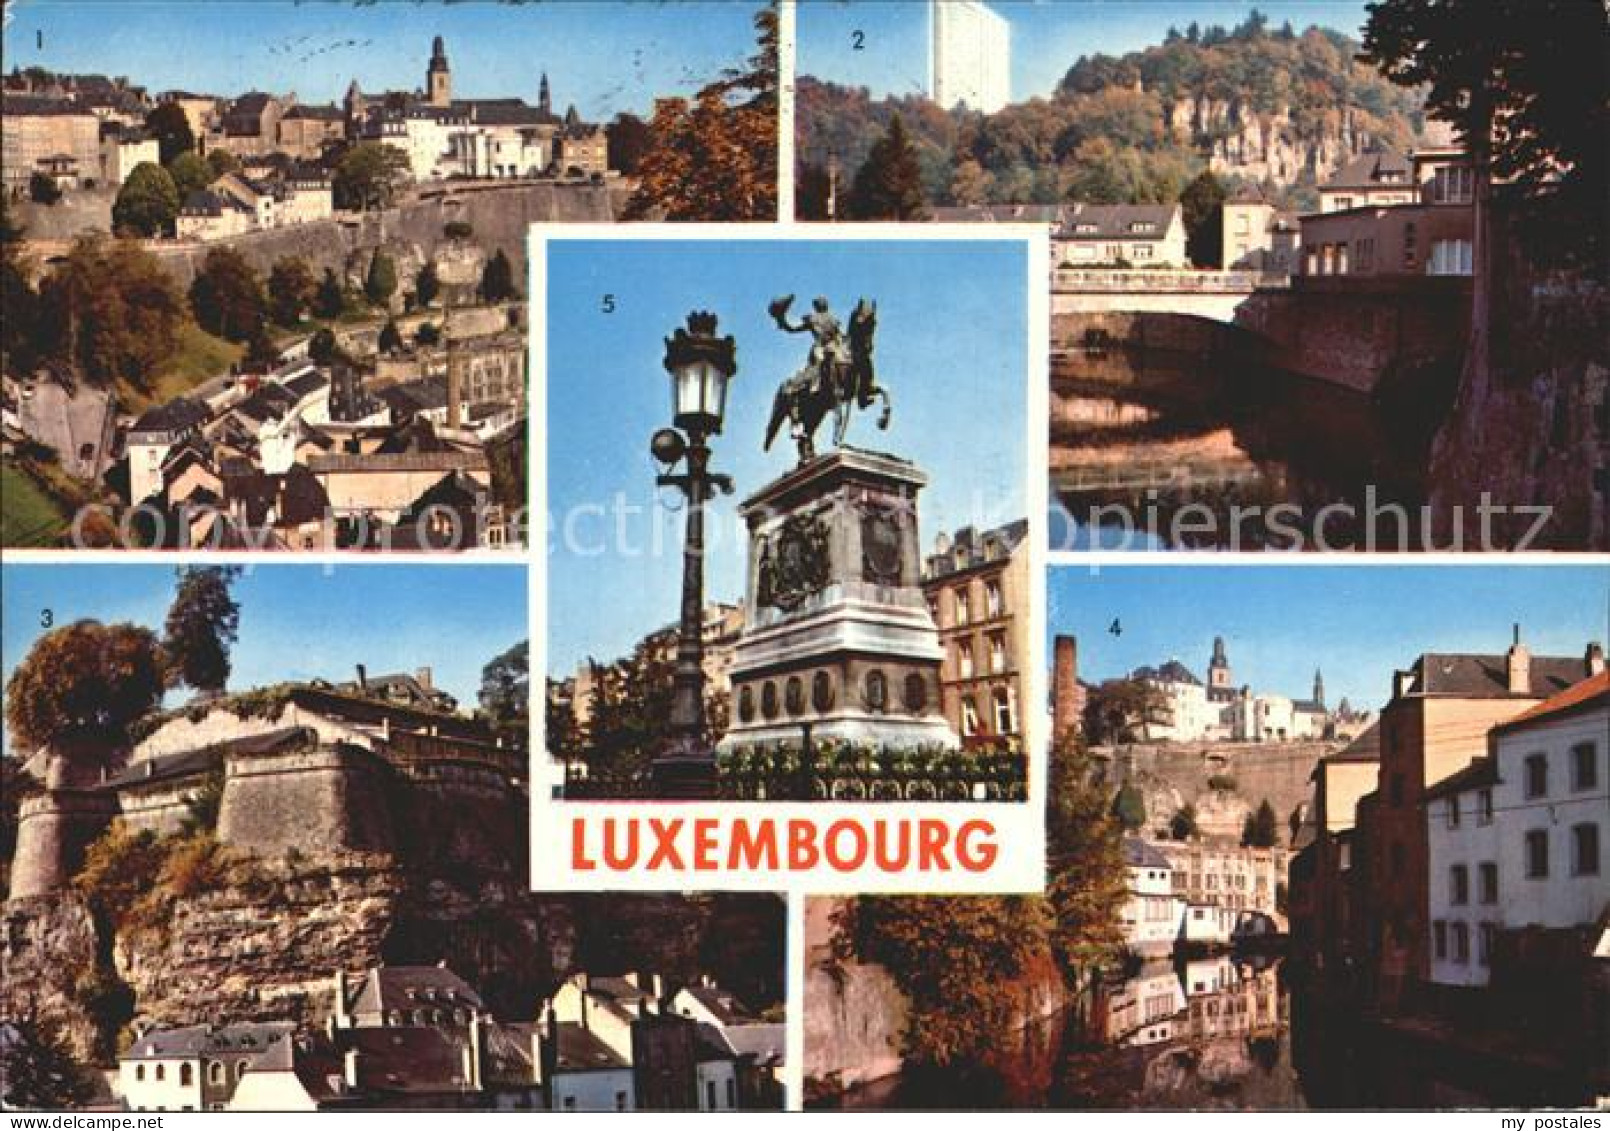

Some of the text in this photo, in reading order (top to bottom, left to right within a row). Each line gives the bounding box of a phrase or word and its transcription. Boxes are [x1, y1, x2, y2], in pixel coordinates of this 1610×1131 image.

[852, 31, 864, 49] 2
[602, 295, 615, 313] 5
[41, 609, 53, 628] 3
[1109, 618, 1122, 636] 4
[571, 818, 999, 873] LUXEMBOURG
